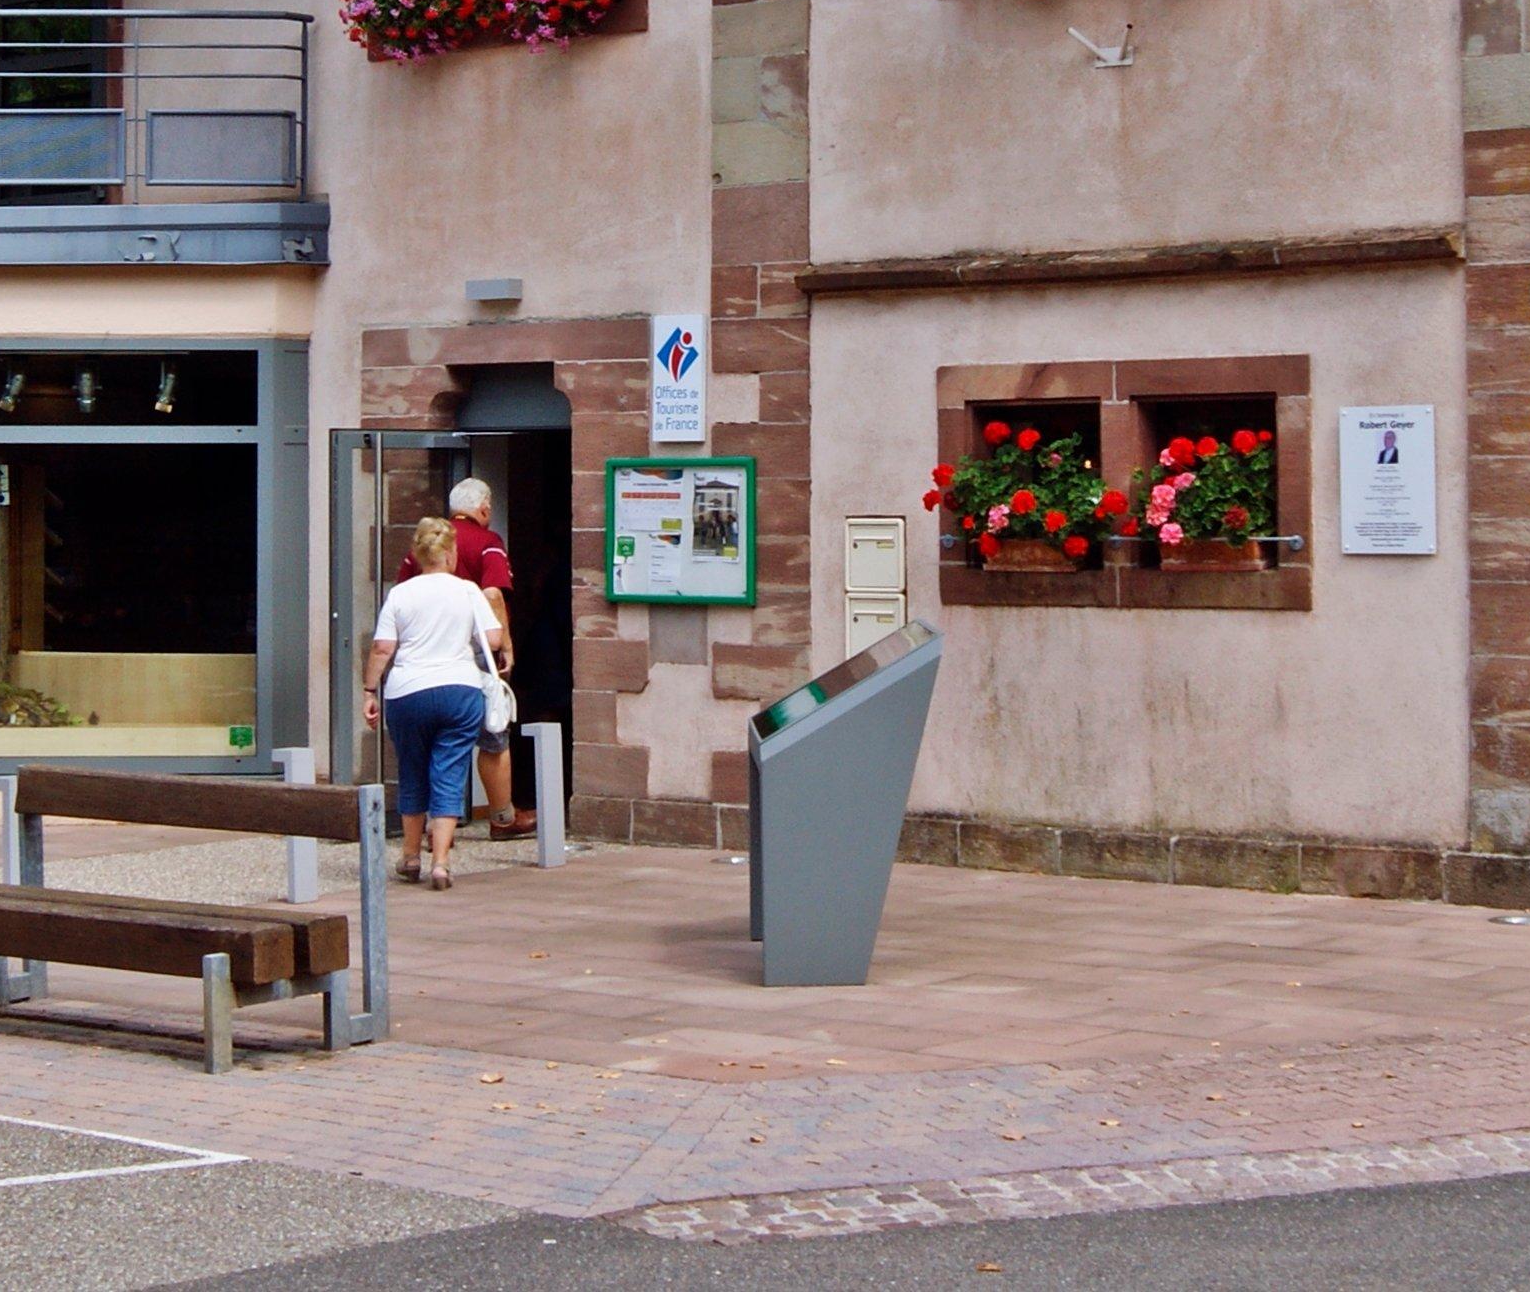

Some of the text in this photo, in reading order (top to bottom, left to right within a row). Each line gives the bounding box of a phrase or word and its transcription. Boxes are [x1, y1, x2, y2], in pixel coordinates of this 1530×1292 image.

[655, 386, 698, 399] Offices de
[656, 402, 698, 414] Tourisme
[655, 417, 698, 430] de France
[1359, 420, 1387, 429] Robert
